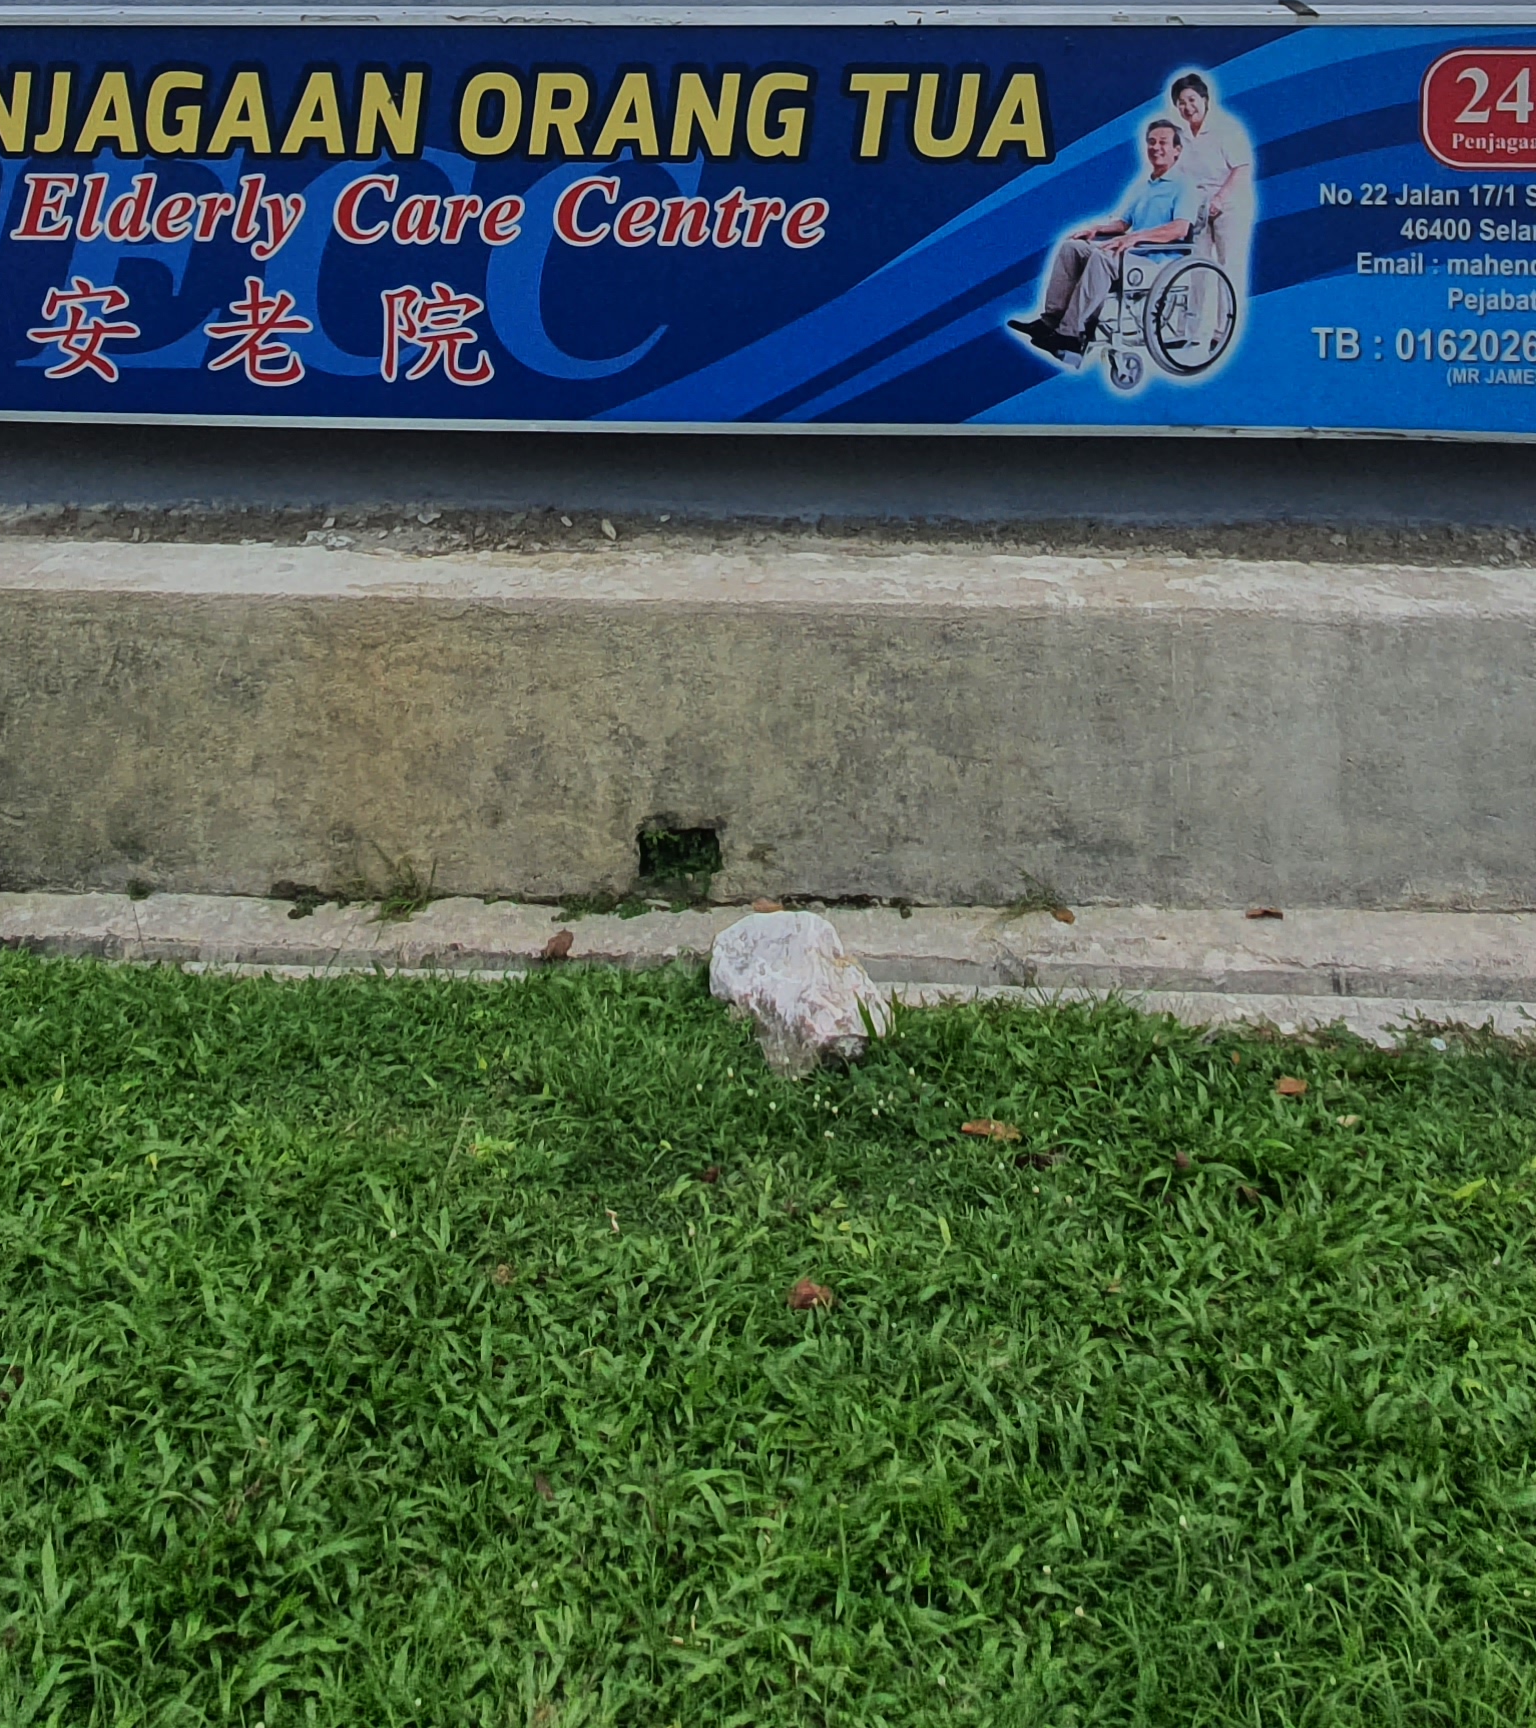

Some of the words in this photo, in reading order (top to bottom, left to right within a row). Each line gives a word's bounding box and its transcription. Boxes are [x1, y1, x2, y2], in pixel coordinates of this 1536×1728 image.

[1454, 67, 1534, 123] 24
[458, 71, 811, 157] ORANG
[849, 72, 1049, 158] TUA
[1319, 182, 1352, 205] No
[1360, 183, 1388, 206] 22
[1395, 183, 1460, 206] Jalan
[1468, 184, 1515, 207] 17/1
[11, 173, 305, 259] Elderly
[334, 175, 524, 248] Care
[553, 177, 828, 249] Centre
[1400, 218, 1470, 240] 46400
[1357, 252, 1424, 274] Email
[27, 277, 495, 386] 安老院
[1311, 327, 1360, 359] TB
[1446, 368, 1480, 387] (MR
